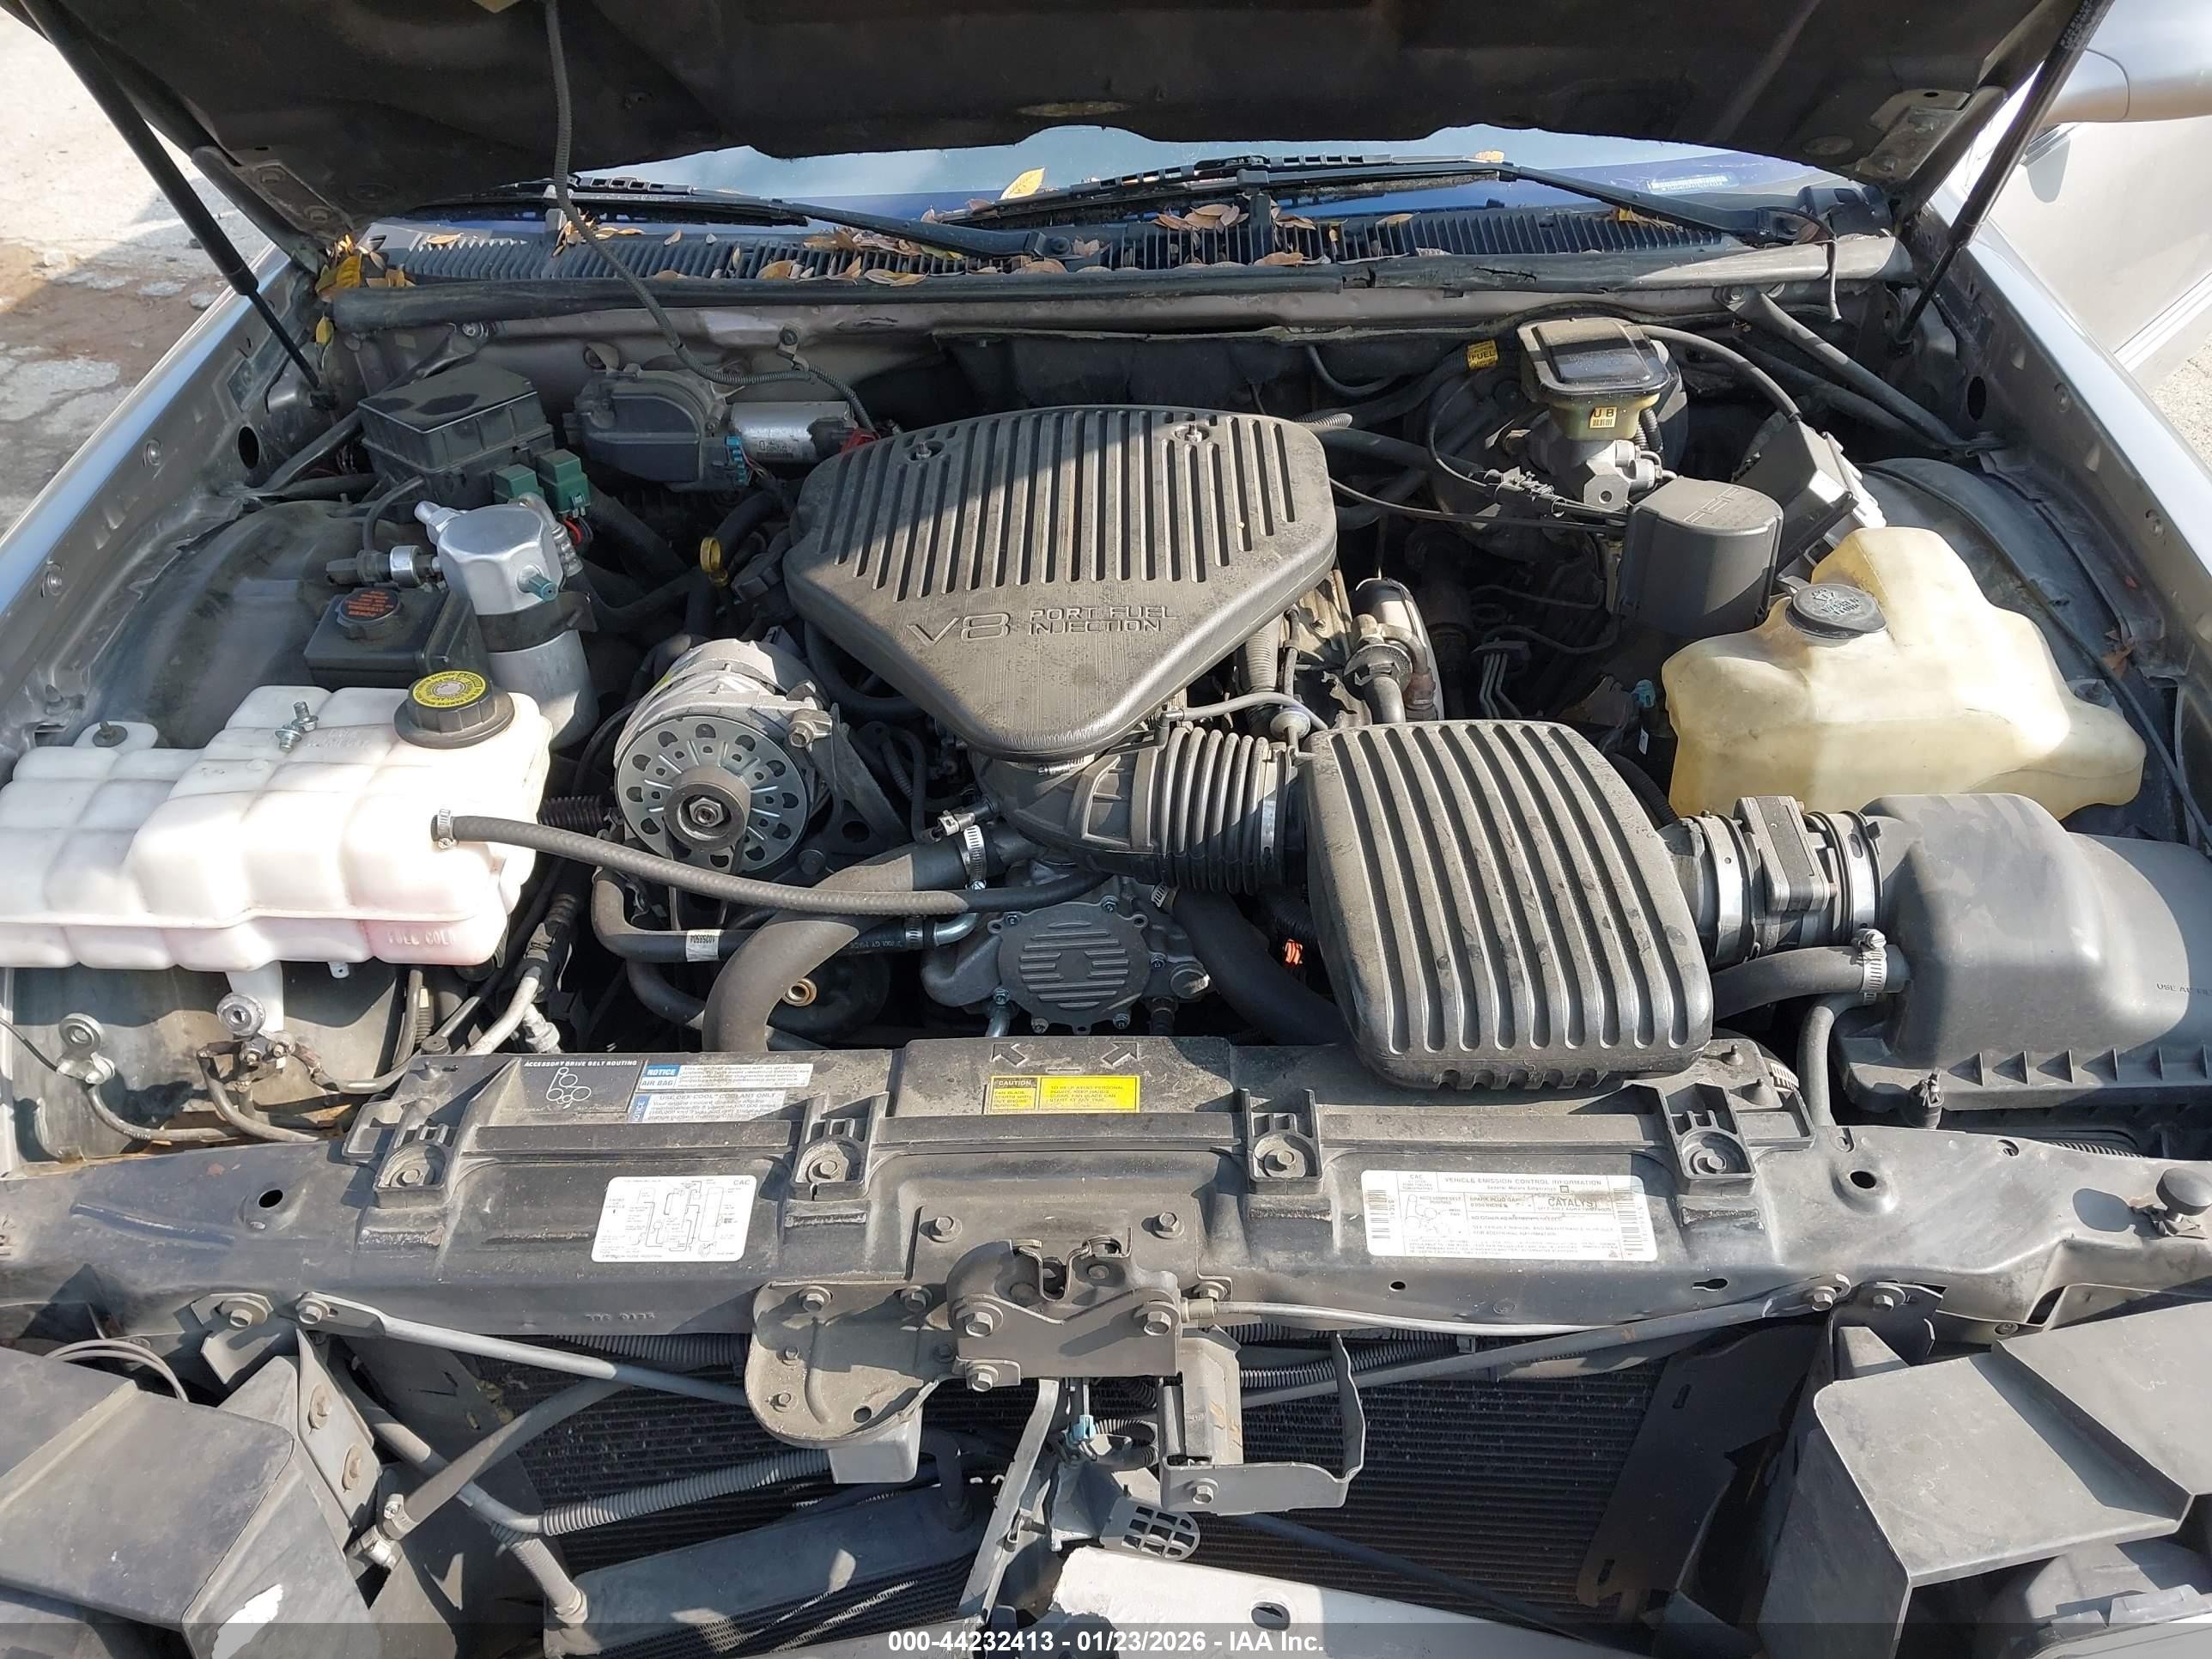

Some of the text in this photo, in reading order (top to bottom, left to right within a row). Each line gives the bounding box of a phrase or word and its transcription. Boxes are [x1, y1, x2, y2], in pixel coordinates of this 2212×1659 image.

[1030, 605, 1177, 621] PORT FUEL
[906, 612, 1012, 646] V8
[1030, 618, 1162, 635] INJECTION
[1547, 1197, 1598, 1208] CATALYST
